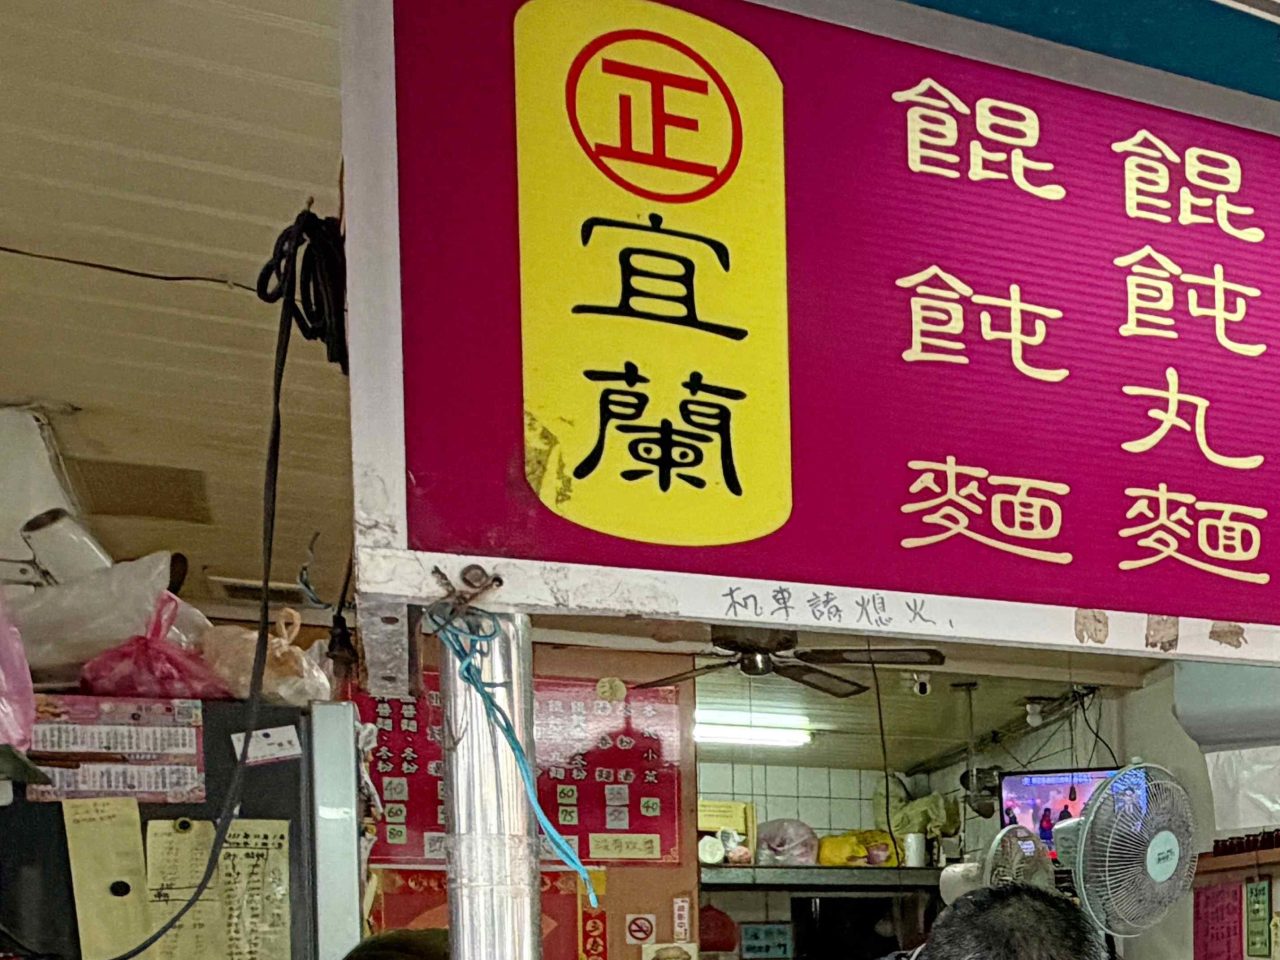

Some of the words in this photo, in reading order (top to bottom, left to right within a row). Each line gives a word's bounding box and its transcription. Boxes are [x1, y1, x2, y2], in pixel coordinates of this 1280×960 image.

[572, 214, 748, 497] 宜蘭
[892, 77, 1073, 565] 餛飩麵
[1112, 129, 1269, 584] 餛飩丸麵
